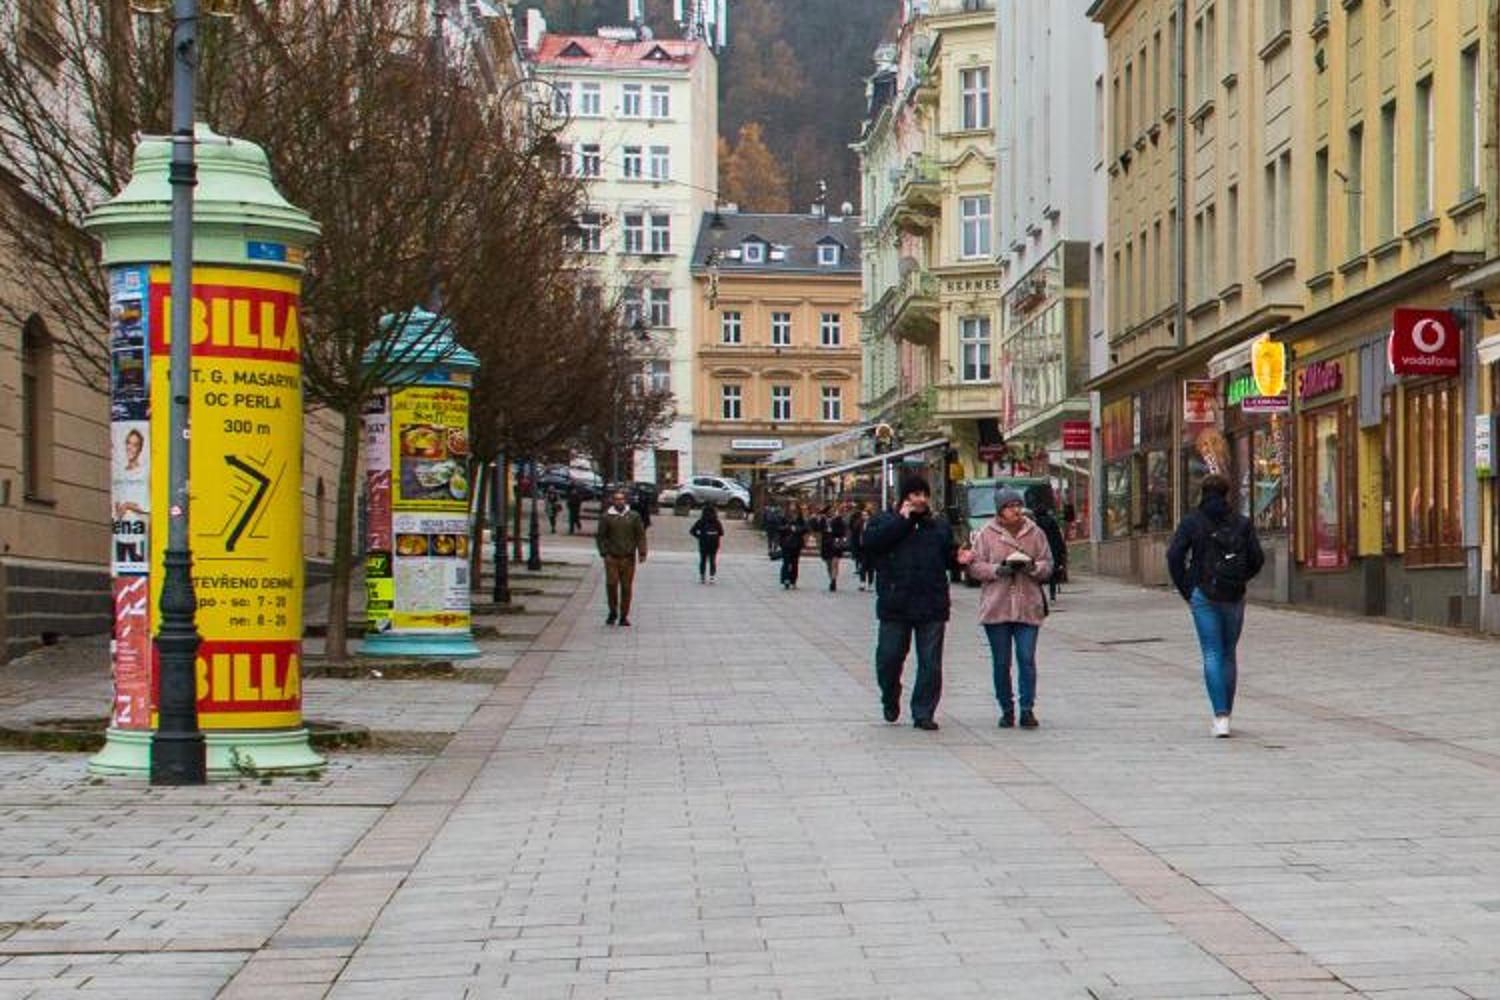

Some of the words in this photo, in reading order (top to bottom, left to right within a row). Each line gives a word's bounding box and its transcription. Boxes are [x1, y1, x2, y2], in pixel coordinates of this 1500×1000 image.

[1401, 355, 1457, 367] vodafone
[204, 392, 229, 407] OC
[233, 393, 282, 409] PERLA
[223, 419, 253, 433] 300
[257, 423, 271, 435] m
[192, 574, 258, 589] TEVŘENO
[196, 653, 299, 701] ILLA
